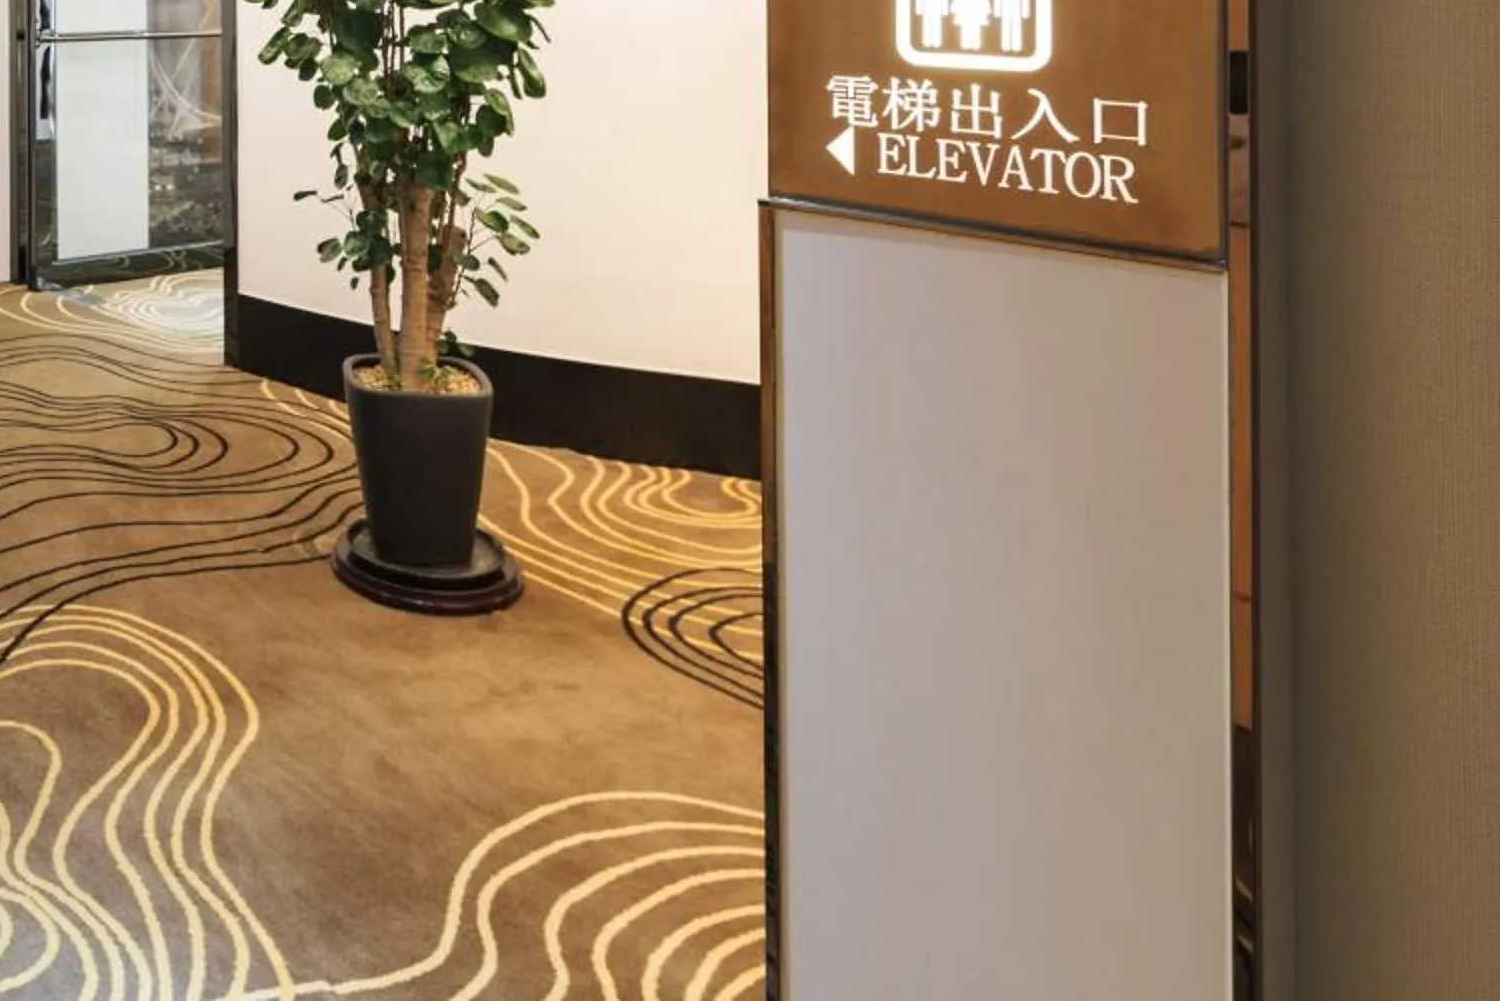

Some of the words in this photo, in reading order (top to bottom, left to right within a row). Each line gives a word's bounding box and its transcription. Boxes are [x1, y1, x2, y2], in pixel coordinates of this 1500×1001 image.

[825, 74, 1149, 147] 電梯出入口
[877, 132, 1140, 204] ELEVATOR
